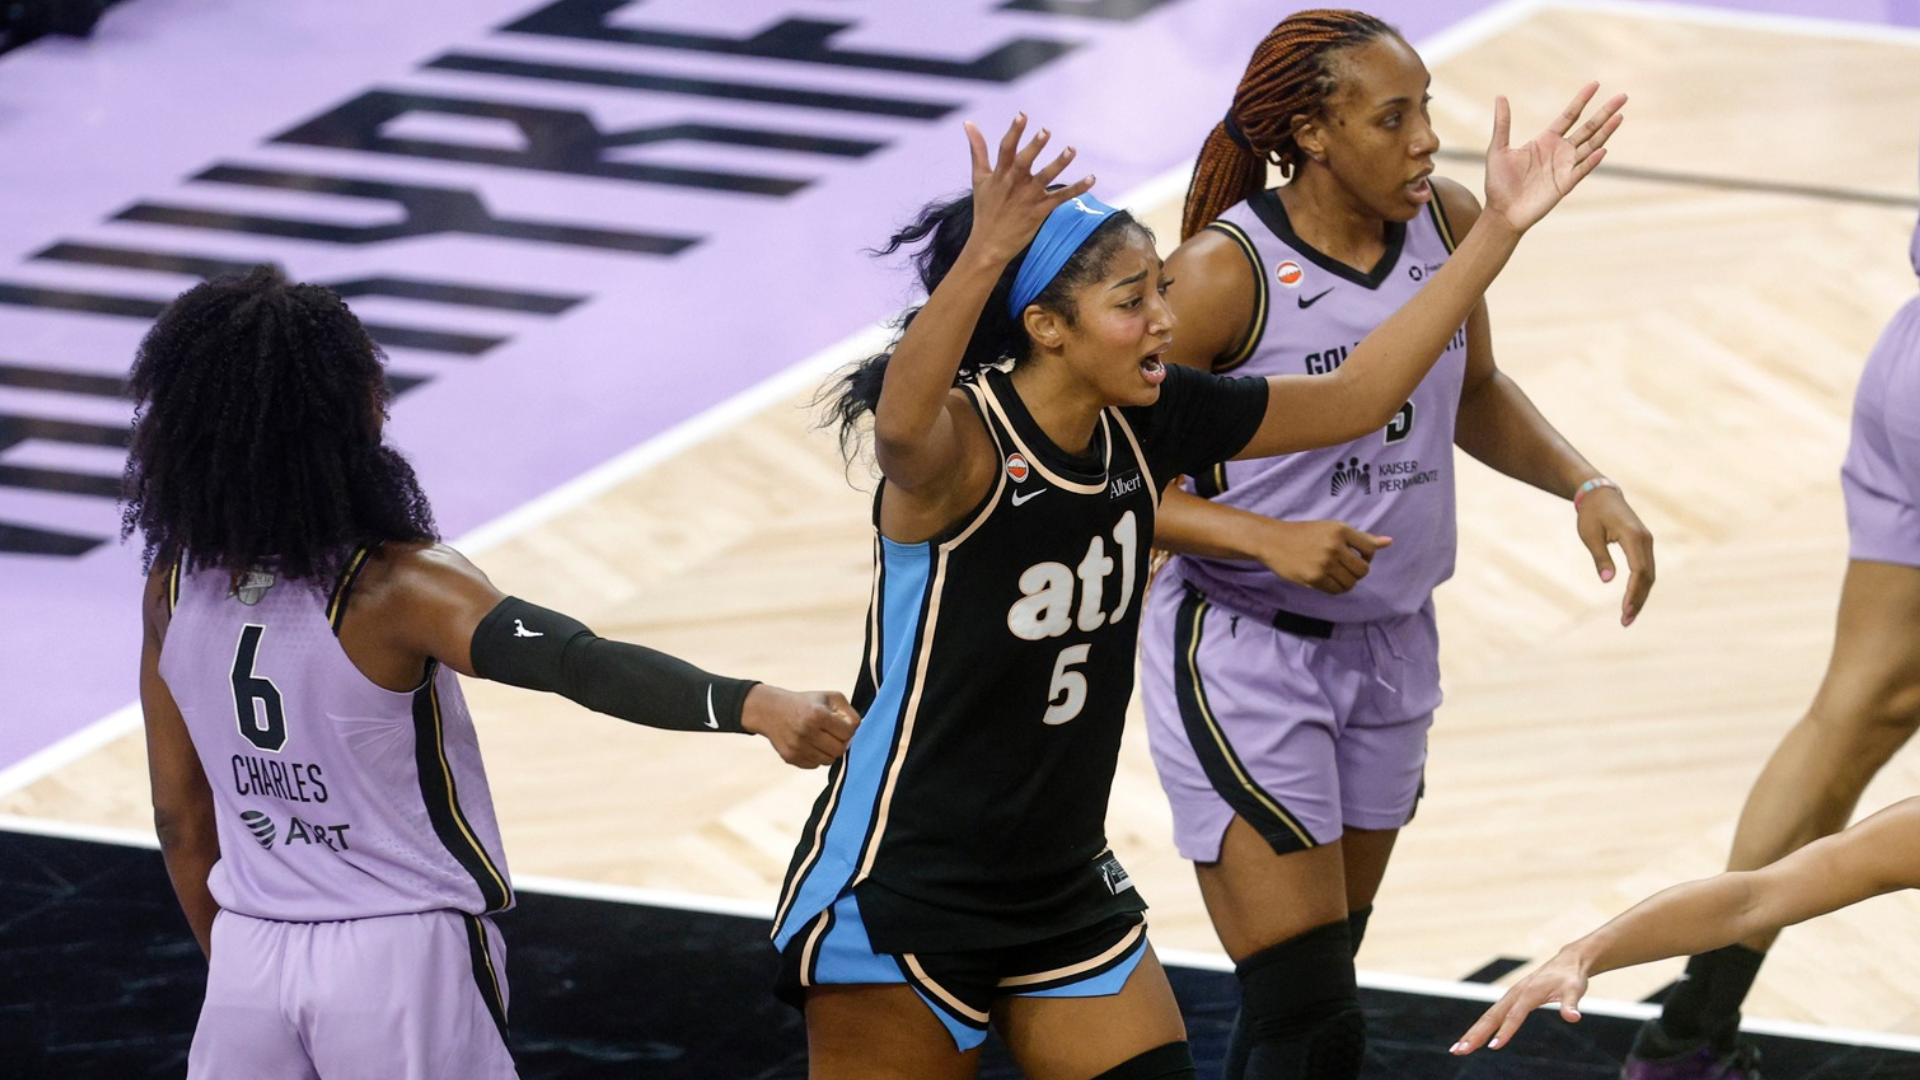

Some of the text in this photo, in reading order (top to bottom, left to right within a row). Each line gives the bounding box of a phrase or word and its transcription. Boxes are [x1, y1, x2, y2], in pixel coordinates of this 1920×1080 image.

[1110, 473, 1141, 499] Albert
[1379, 460, 1418, 477] KAISER
[1007, 510, 1138, 641] atl
[229, 623, 288, 754] 6
[1043, 643, 1092, 725] 5
[231, 754, 328, 803] CHARLES
